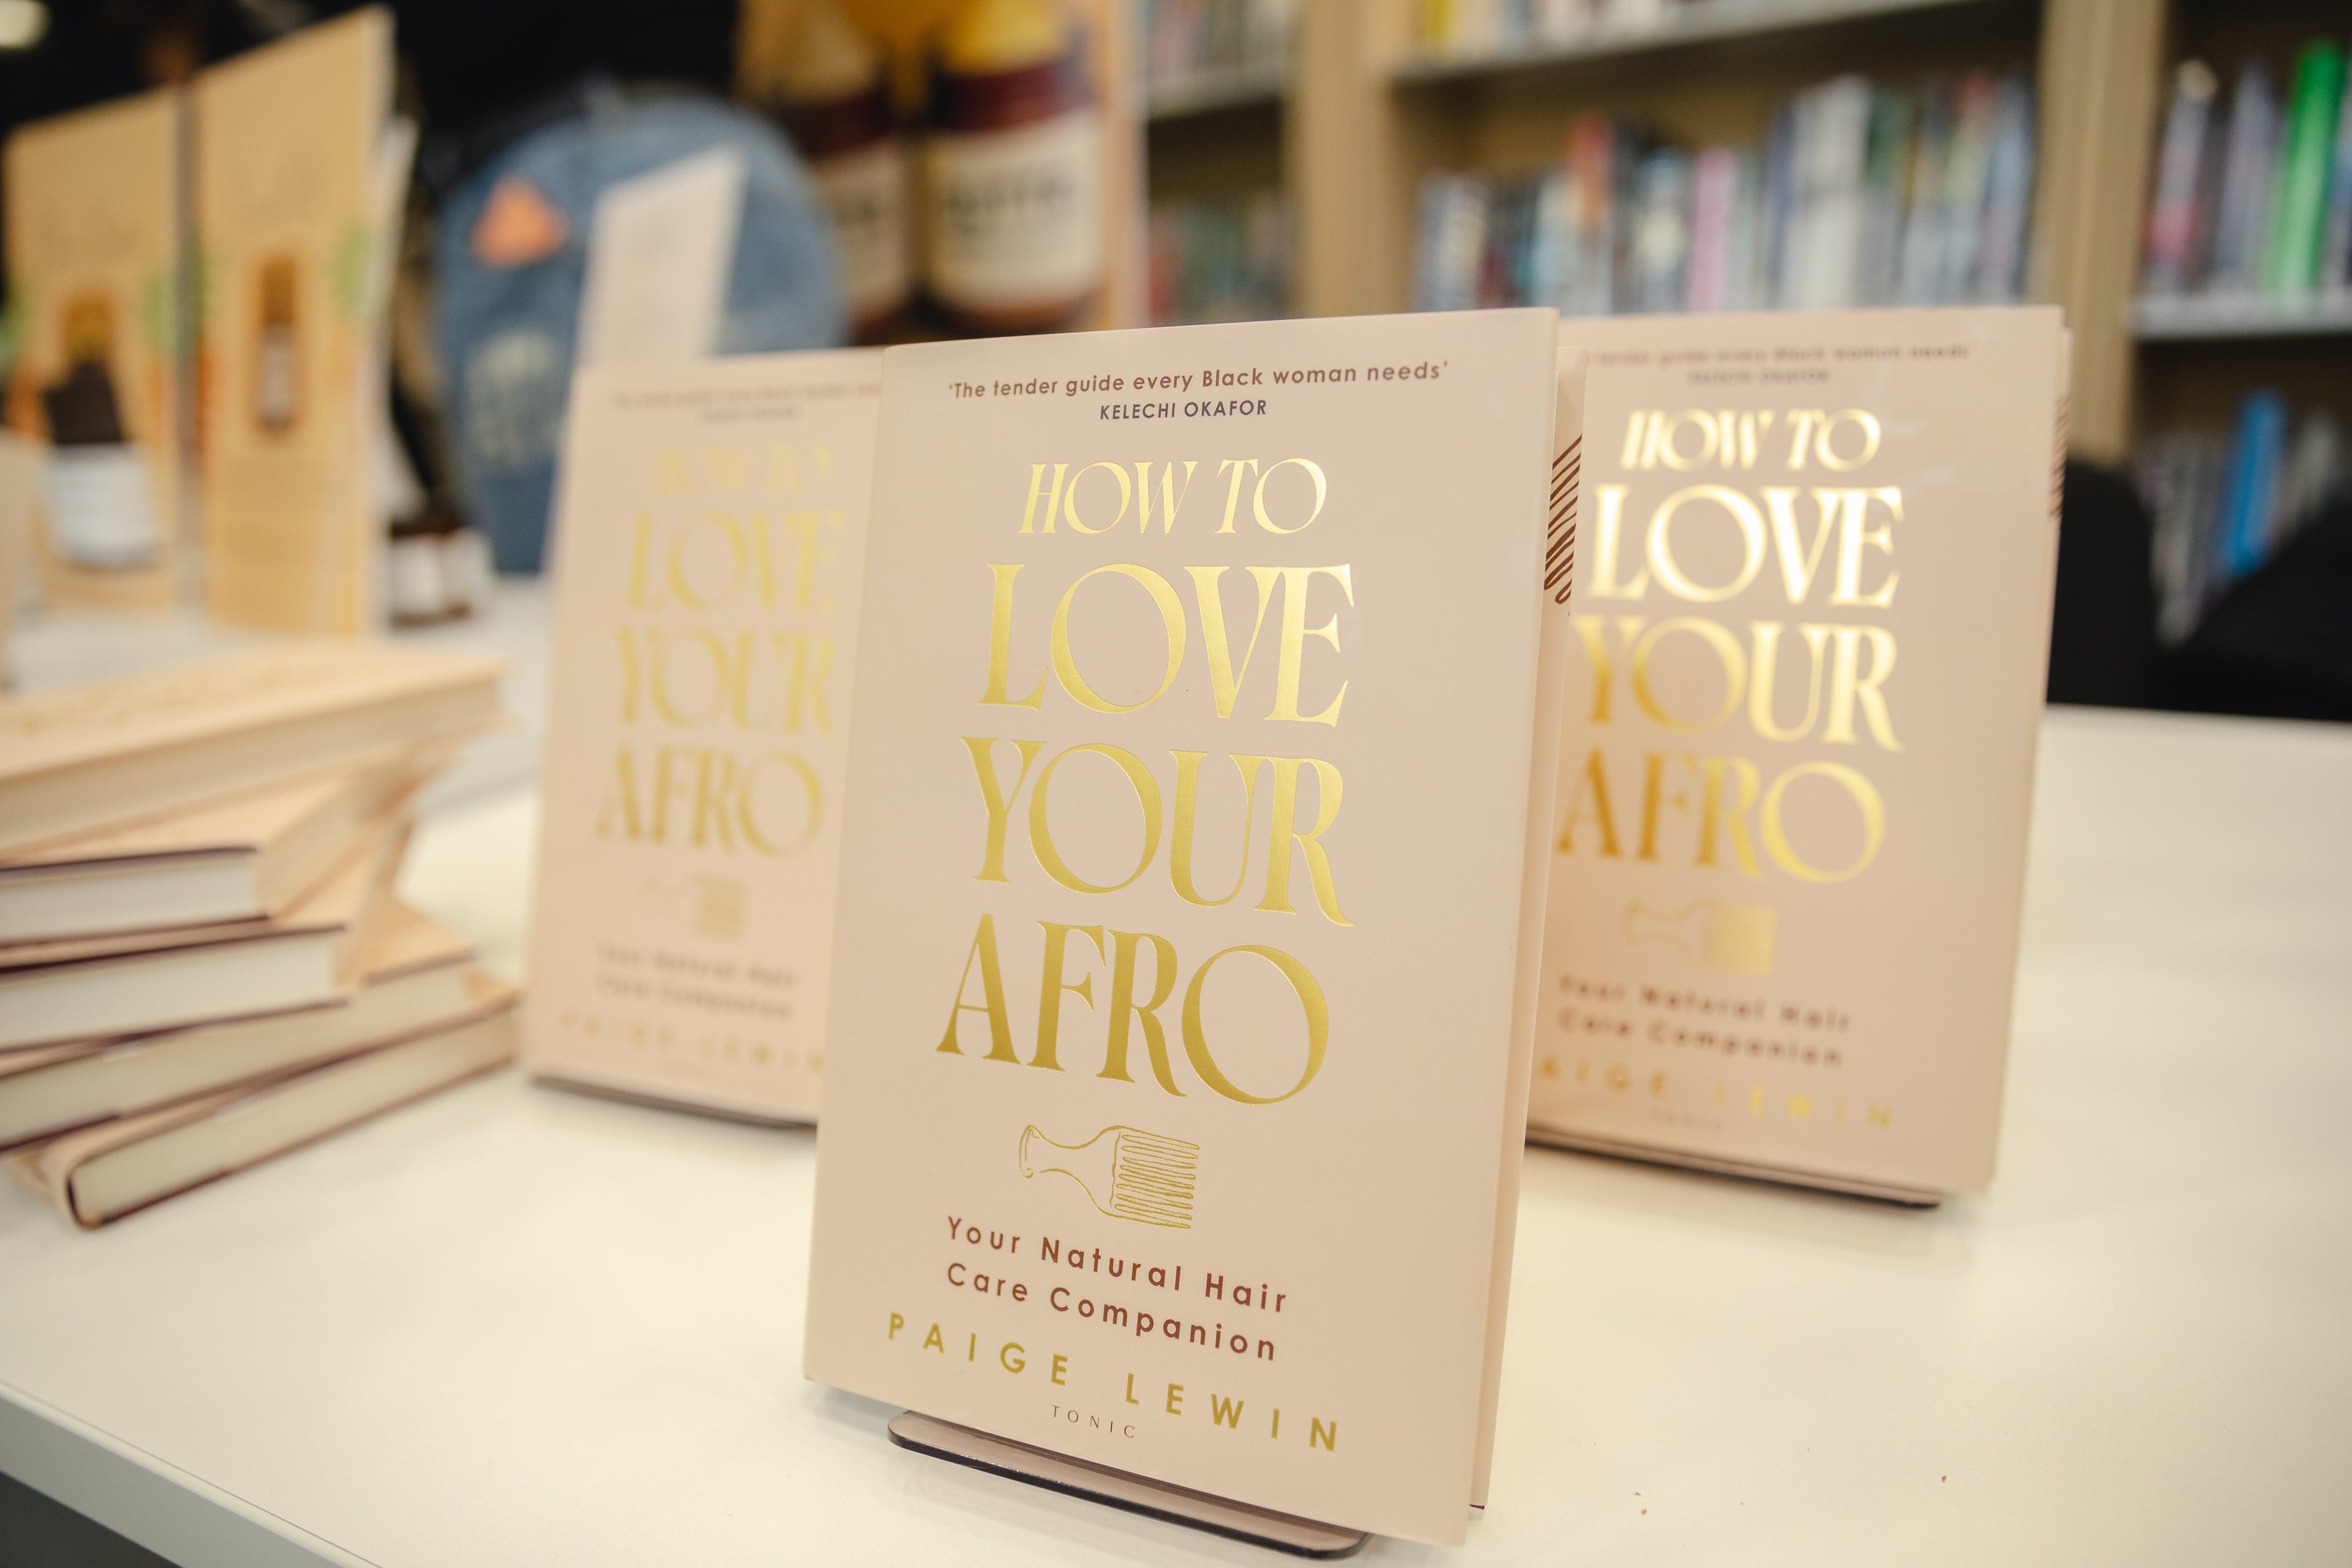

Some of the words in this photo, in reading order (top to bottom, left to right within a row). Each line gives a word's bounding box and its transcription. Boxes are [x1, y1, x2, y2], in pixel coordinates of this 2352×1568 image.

[993, 377, 1058, 398] tender
[1065, 374, 1125, 396] guide
[1132, 370, 1194, 393] every
[1202, 367, 1264, 388] Black
[1272, 364, 1357, 385] woman
[1099, 401, 1177, 420] KELECHI
[1183, 399, 1268, 418] OKAFOR
[1619, 407, 1776, 473] HOW
[1784, 407, 1882, 473] TO
[1018, 459, 1199, 536] HOW
[1216, 457, 1328, 536] TO
[1585, 482, 1906, 611] LOVE
[976, 562, 1356, 727] LOVE
[1571, 613, 1907, 754] YOUR
[594, 743, 826, 859] AFRO
[960, 735, 1355, 928] YOUR
[1553, 746, 1888, 884] AFRO
[935, 912, 1329, 1106] AFRO
[1535, 1053, 1668, 1099] AIGE
[947, 1215, 1022, 1254] Your
[1041, 1237, 1182, 1291] Natural
[1205, 1272, 1288, 1314] Hair
[947, 1262, 1029, 1303] Care
[1049, 1286, 1276, 1362] Companion
[888, 1312, 1070, 1387] PAIGE
[1124, 1372, 1339, 1453] LEWIN
[1050, 1404, 1137, 1440] TONIC
